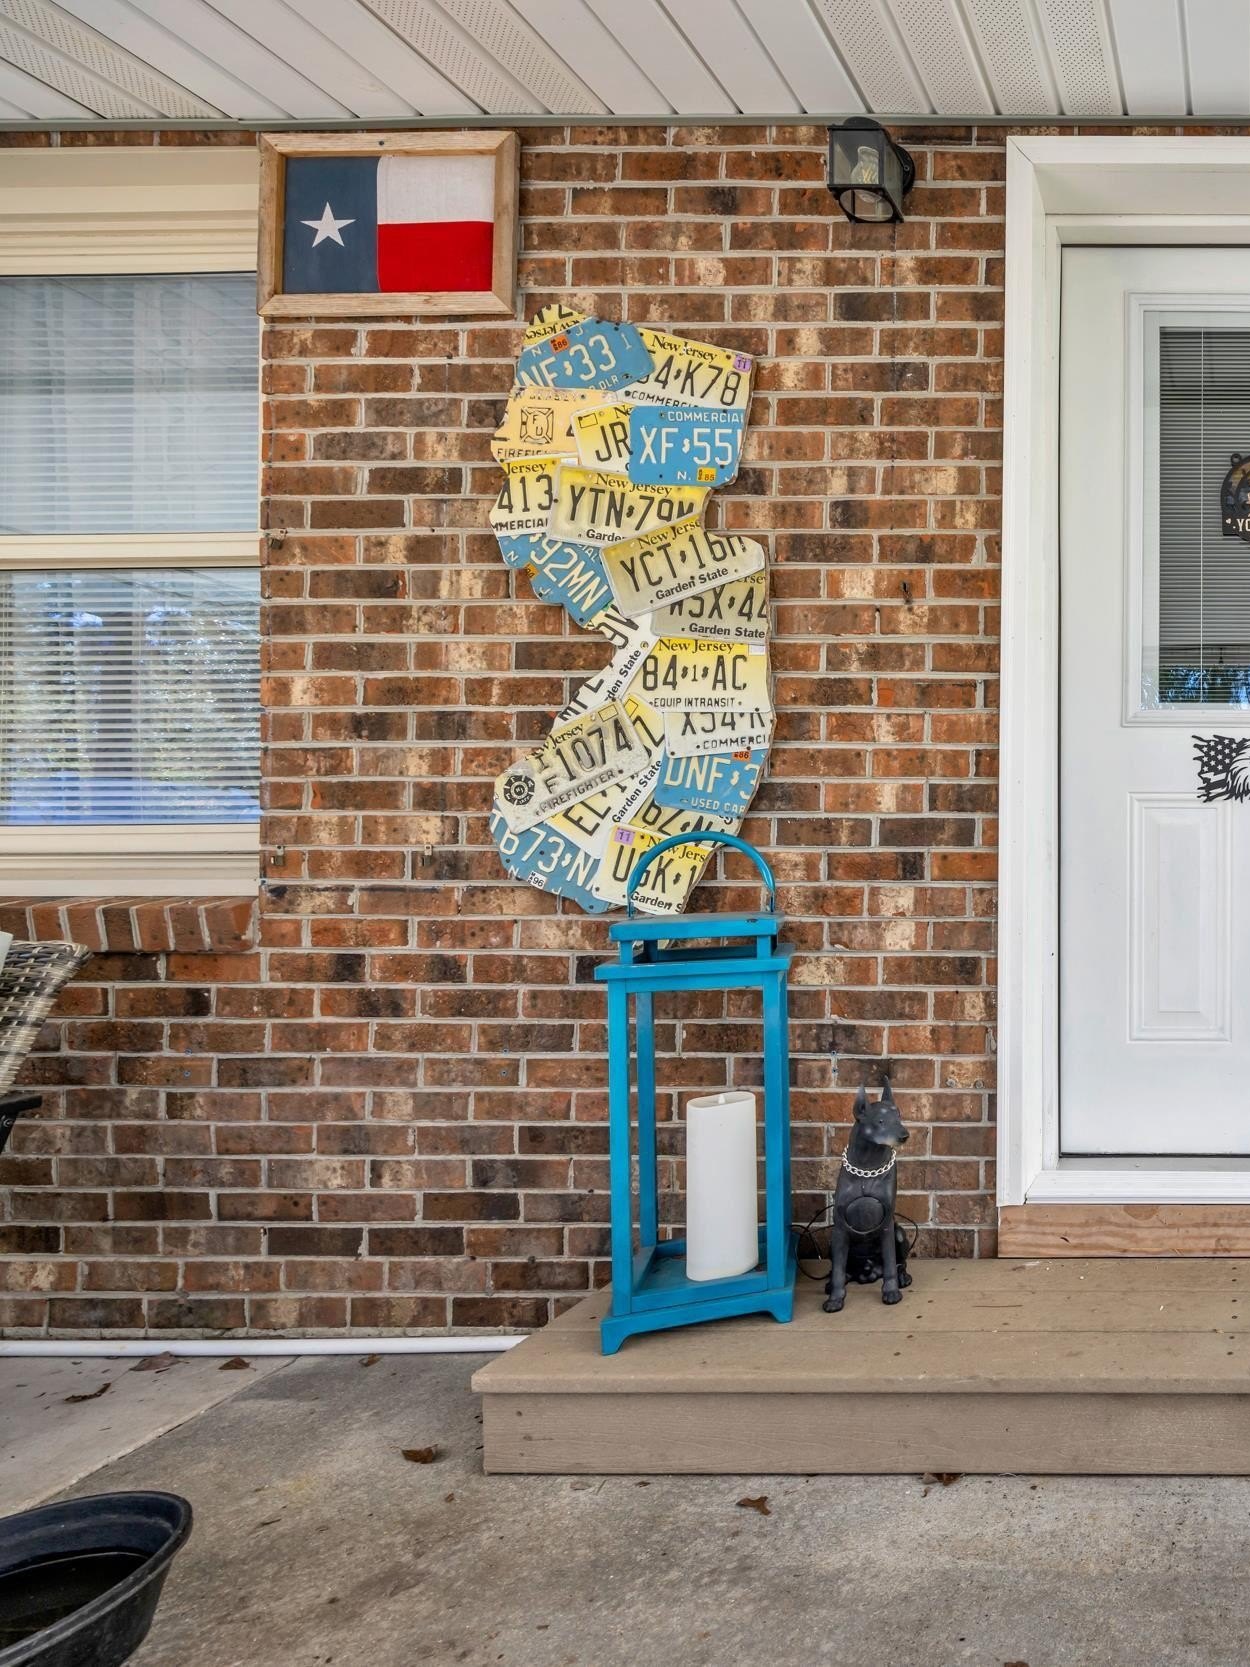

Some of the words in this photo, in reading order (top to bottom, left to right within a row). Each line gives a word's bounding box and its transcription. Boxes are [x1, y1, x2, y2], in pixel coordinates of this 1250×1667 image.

[651, 334, 681, 351] New
[679, 341, 718, 363] Jersey
[504, 462, 547, 476] Jersey
[594, 473, 629, 489] New
[629, 484, 673, 498] Jersey
[586, 528, 624, 542] Garde
[638, 531, 669, 549] New
[655, 579, 696, 600] Garden
[697, 567, 729, 585] State
[689, 622, 731, 635] Garden
[734, 626, 765, 639] State
[658, 639, 691, 652] New
[691, 639, 735, 654] Jersey
[618, 650, 641, 677] State
[653, 697, 682, 708] EQUIP
[550, 723, 584, 749] Jersey
[556, 718, 633, 782] 1074
[539, 768, 616, 814] FIREFIGHTER
[611, 786, 642, 823] Garden
[638, 759, 662, 788] State
[691, 797, 719, 811] USED
[533, 876, 545, 888] 96
[630, 891, 673, 911] Garden
